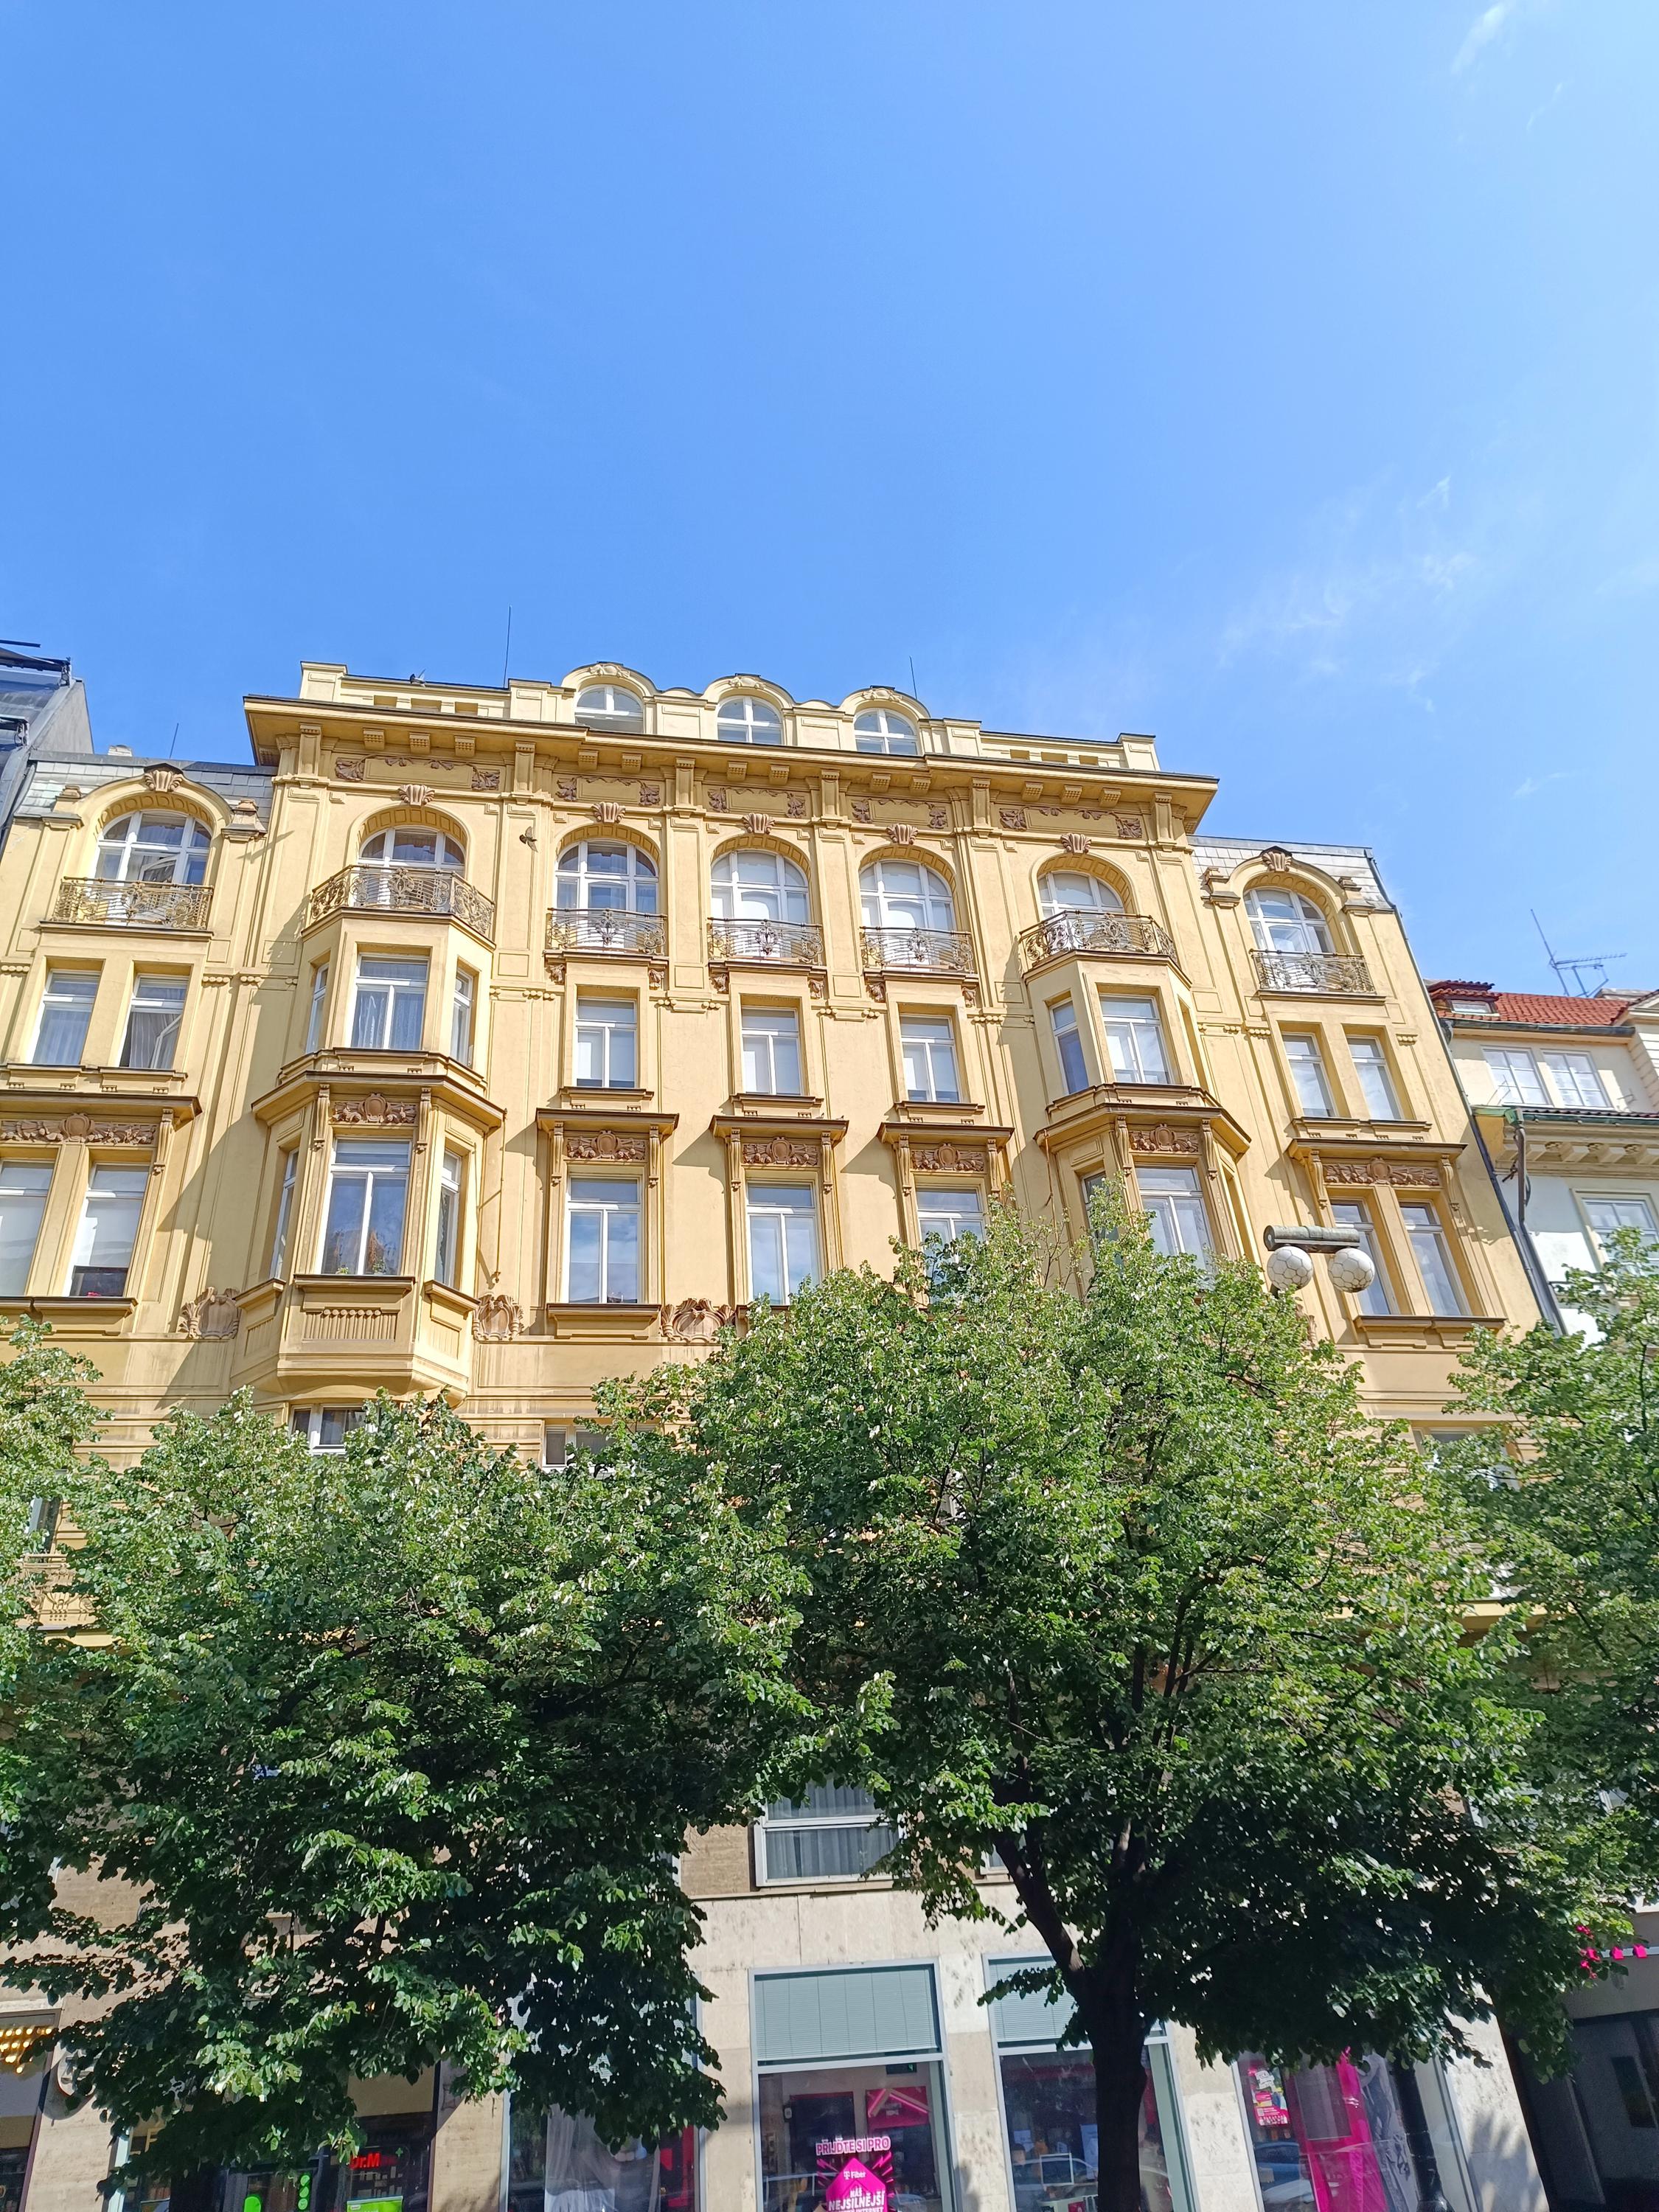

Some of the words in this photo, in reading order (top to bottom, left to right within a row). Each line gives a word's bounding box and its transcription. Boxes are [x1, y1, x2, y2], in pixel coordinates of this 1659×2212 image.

[815, 2135, 856, 2156] PŘIJĎTE
[856, 2138, 866, 2153] SI
[866, 2135, 891, 2152] PRO
[829, 2190, 885, 2211] NEJSILNĚJŠÍ
